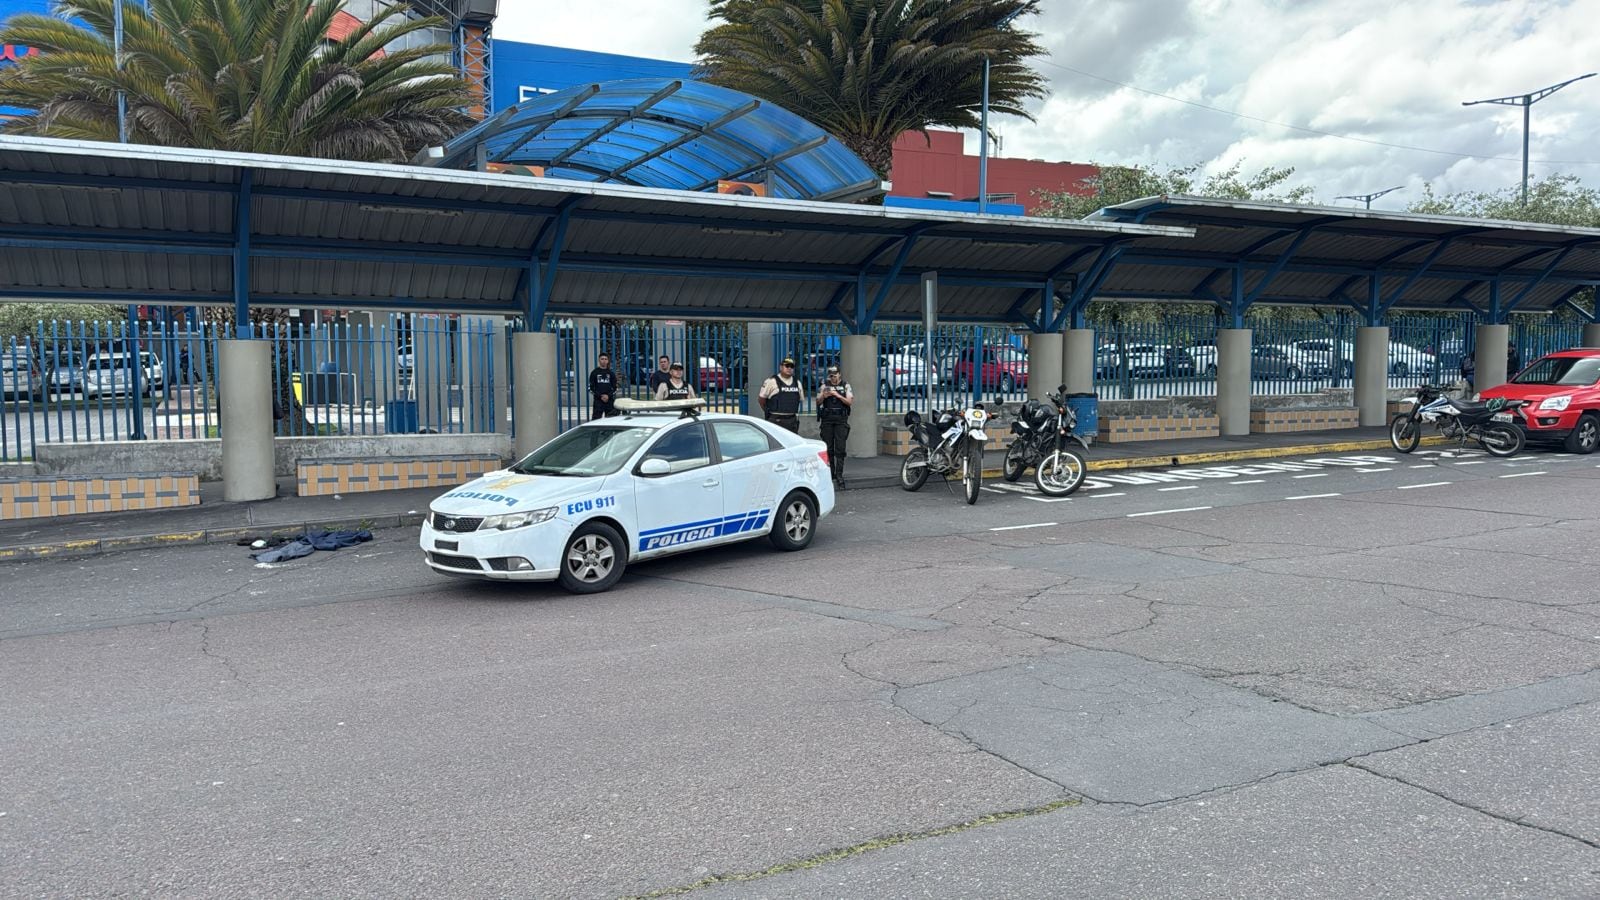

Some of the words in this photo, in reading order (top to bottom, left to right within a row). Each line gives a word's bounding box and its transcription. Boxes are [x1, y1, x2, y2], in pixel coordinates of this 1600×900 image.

[567, 500, 593, 515] ECU
[595, 496, 615, 508] 911
[646, 527, 716, 550] POLICIA
